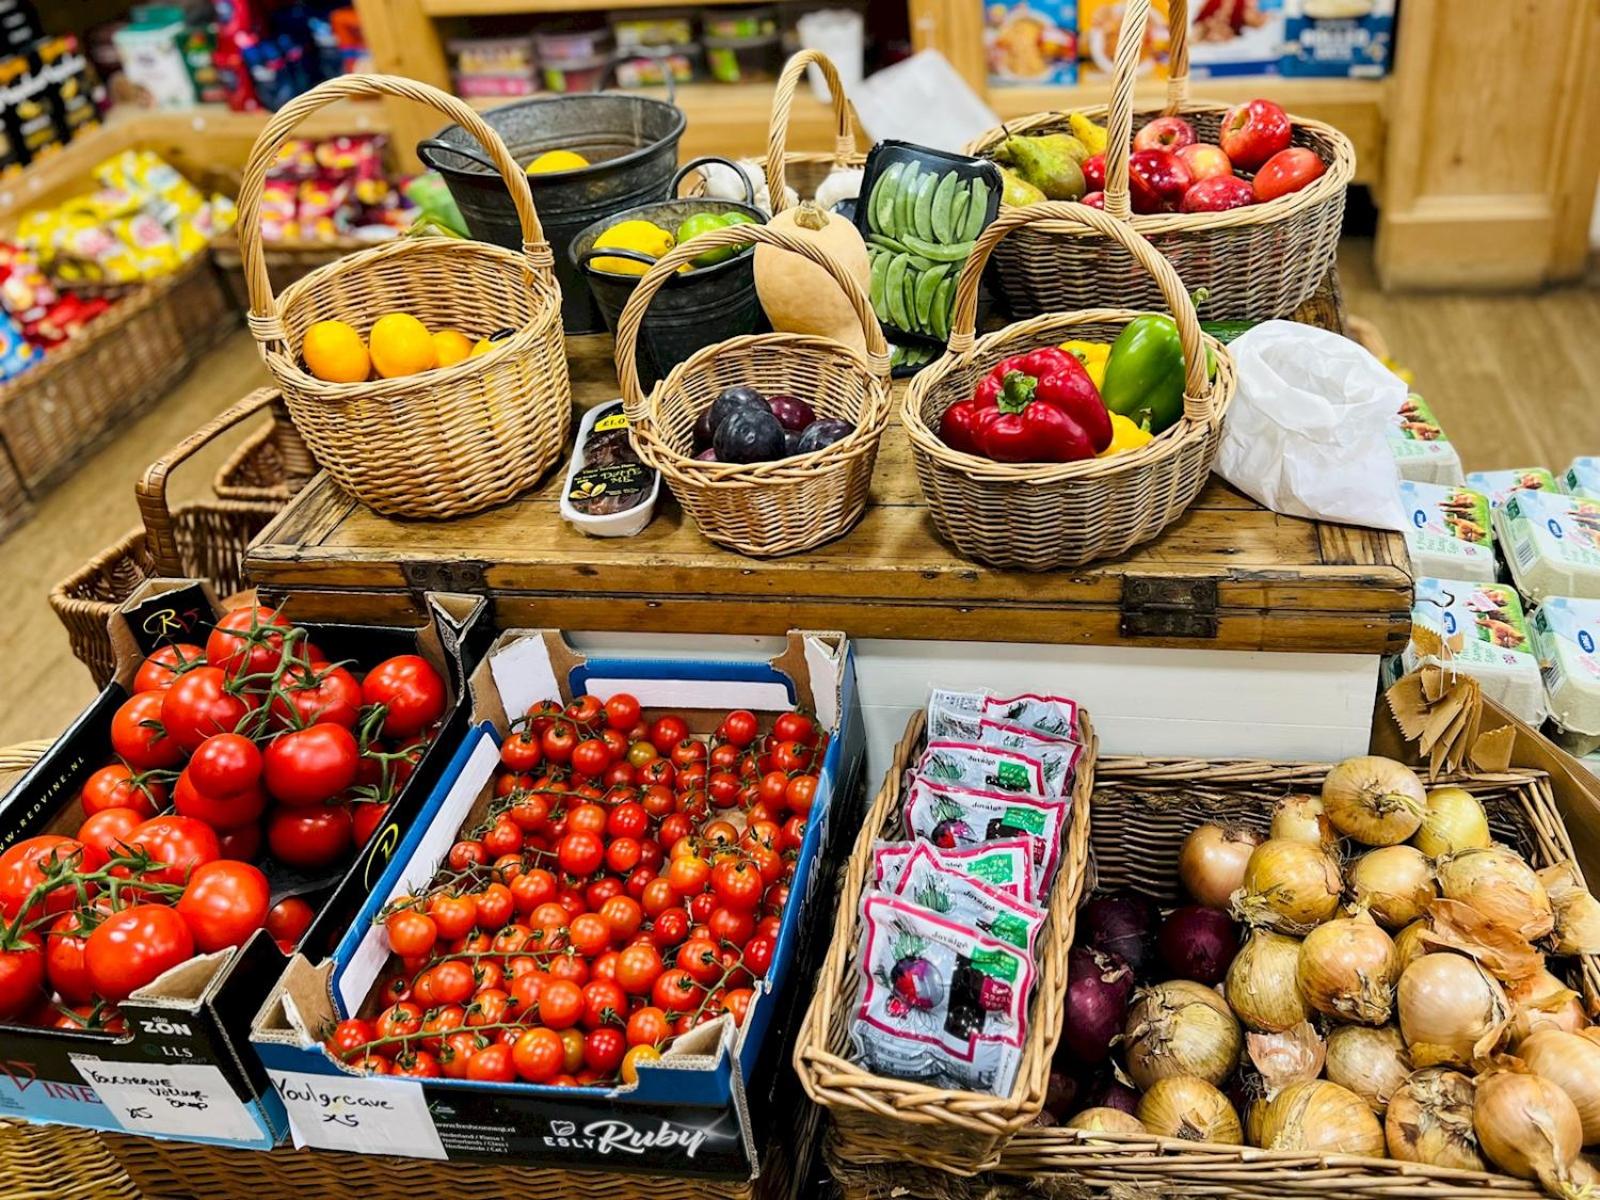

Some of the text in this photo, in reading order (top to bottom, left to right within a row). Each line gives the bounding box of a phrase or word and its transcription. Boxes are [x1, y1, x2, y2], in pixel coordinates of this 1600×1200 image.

[139, 1020, 193, 1037] ZON
[161, 1046, 194, 1058] LLS
[272, 1078, 395, 1110] Youlgreave
[543, 1119, 709, 1159] ESLY Ruby
